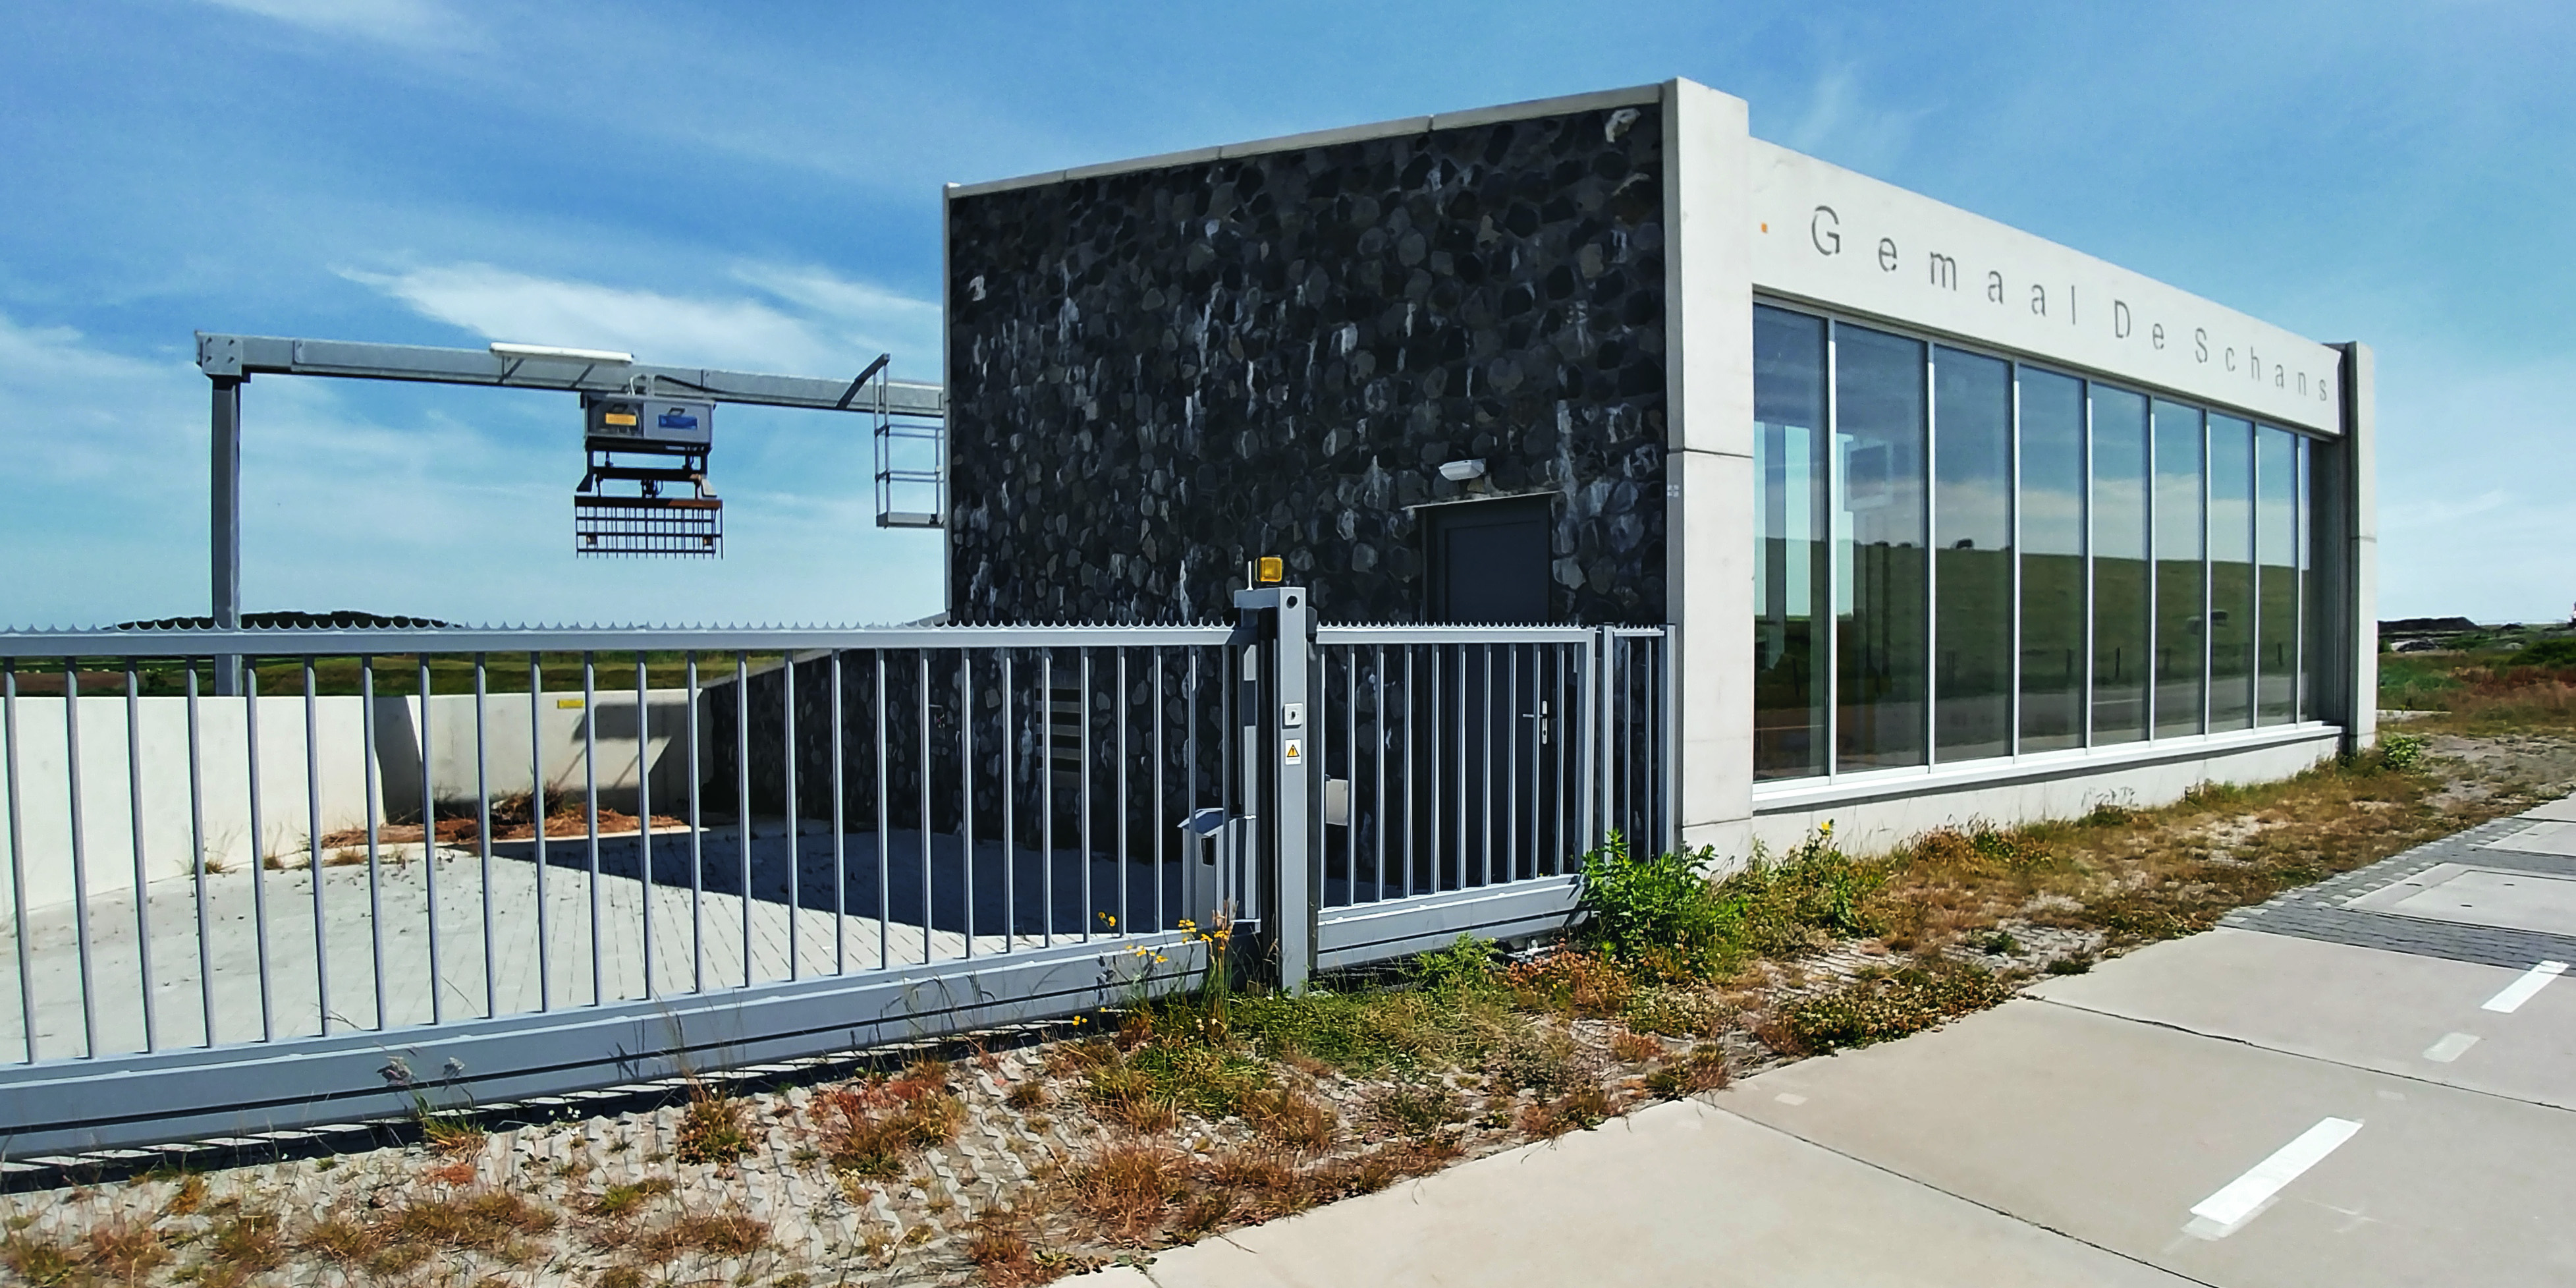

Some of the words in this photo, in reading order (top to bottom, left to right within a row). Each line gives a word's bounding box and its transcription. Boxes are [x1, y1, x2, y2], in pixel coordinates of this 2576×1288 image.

[1811, 205, 2077, 325] Gemaal
[2114, 299, 2166, 350] De
[2195, 327, 2327, 401] Schans
